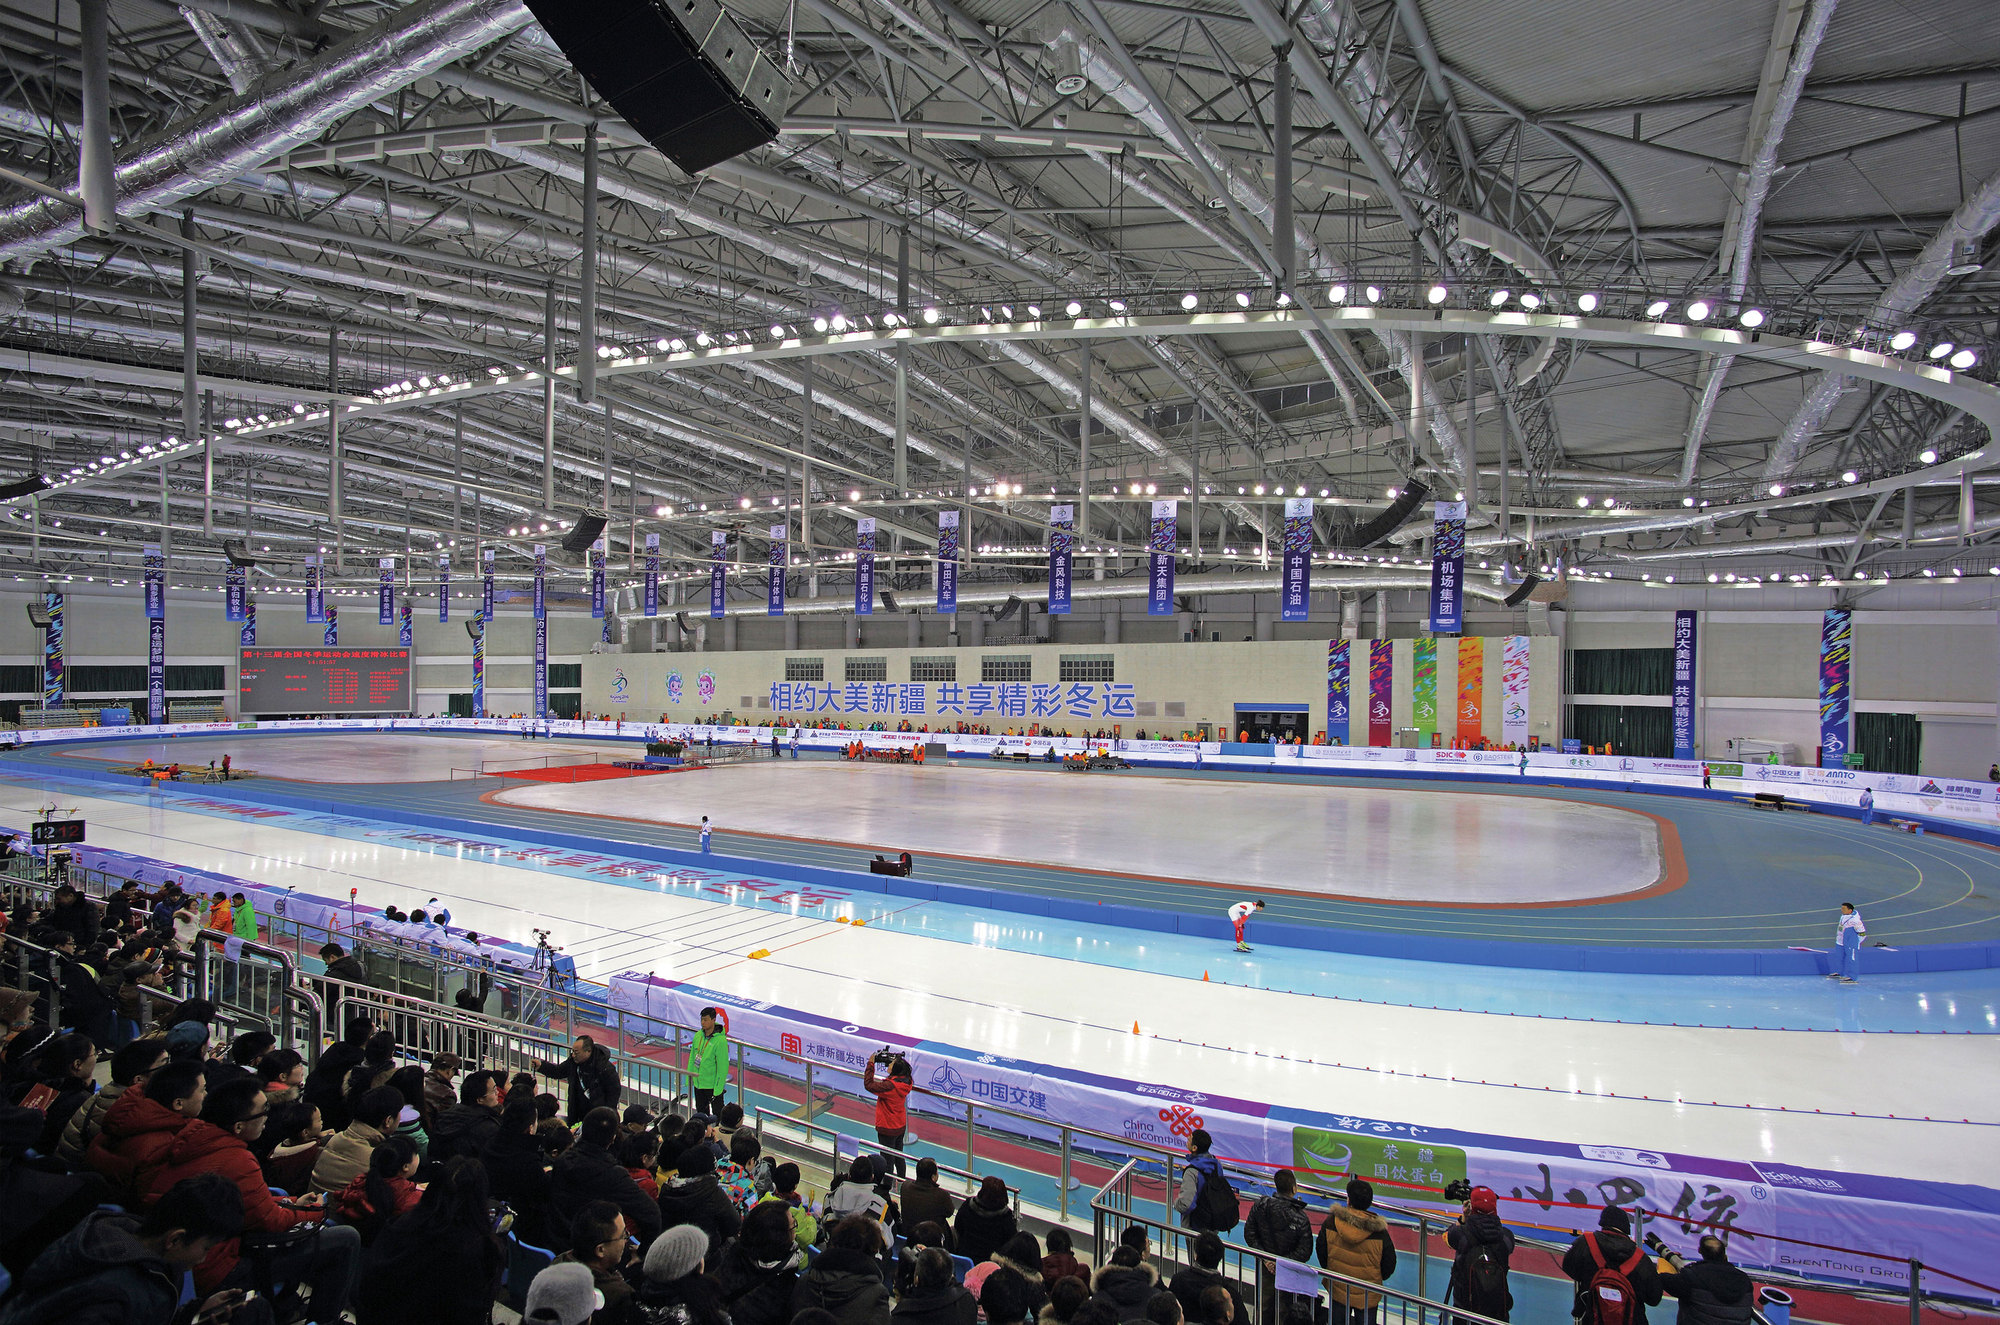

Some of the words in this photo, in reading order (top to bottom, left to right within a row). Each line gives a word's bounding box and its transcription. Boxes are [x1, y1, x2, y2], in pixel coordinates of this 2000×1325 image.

[860, 564, 870, 602] 中国石化
[1055, 555, 1066, 600] 金风科技
[1156, 555, 1168, 600] 新天集团
[1289, 555, 1303, 606] 中国石油
[1439, 561, 1455, 615] 机场集团
[536, 617, 545, 661] 约大美新疆
[1676, 617, 1691, 681] 相约大美新疆
[769, 681, 927, 715] 相约大美新疆
[936, 681, 1136, 719] 共享精彩冬运
[1675, 685, 1690, 749] 共享精彩冬运
[1771, 769, 1801, 778] 中国交建
[34, 826, 55, 840] 12
[58, 824, 80, 838] 12
[971, 1078, 1048, 1112] 中国交建
[1123, 1119, 1155, 1132] China
[1124, 1129, 1164, 1144] unicom
[1374, 1163, 1444, 1185] 国饮蛋白
